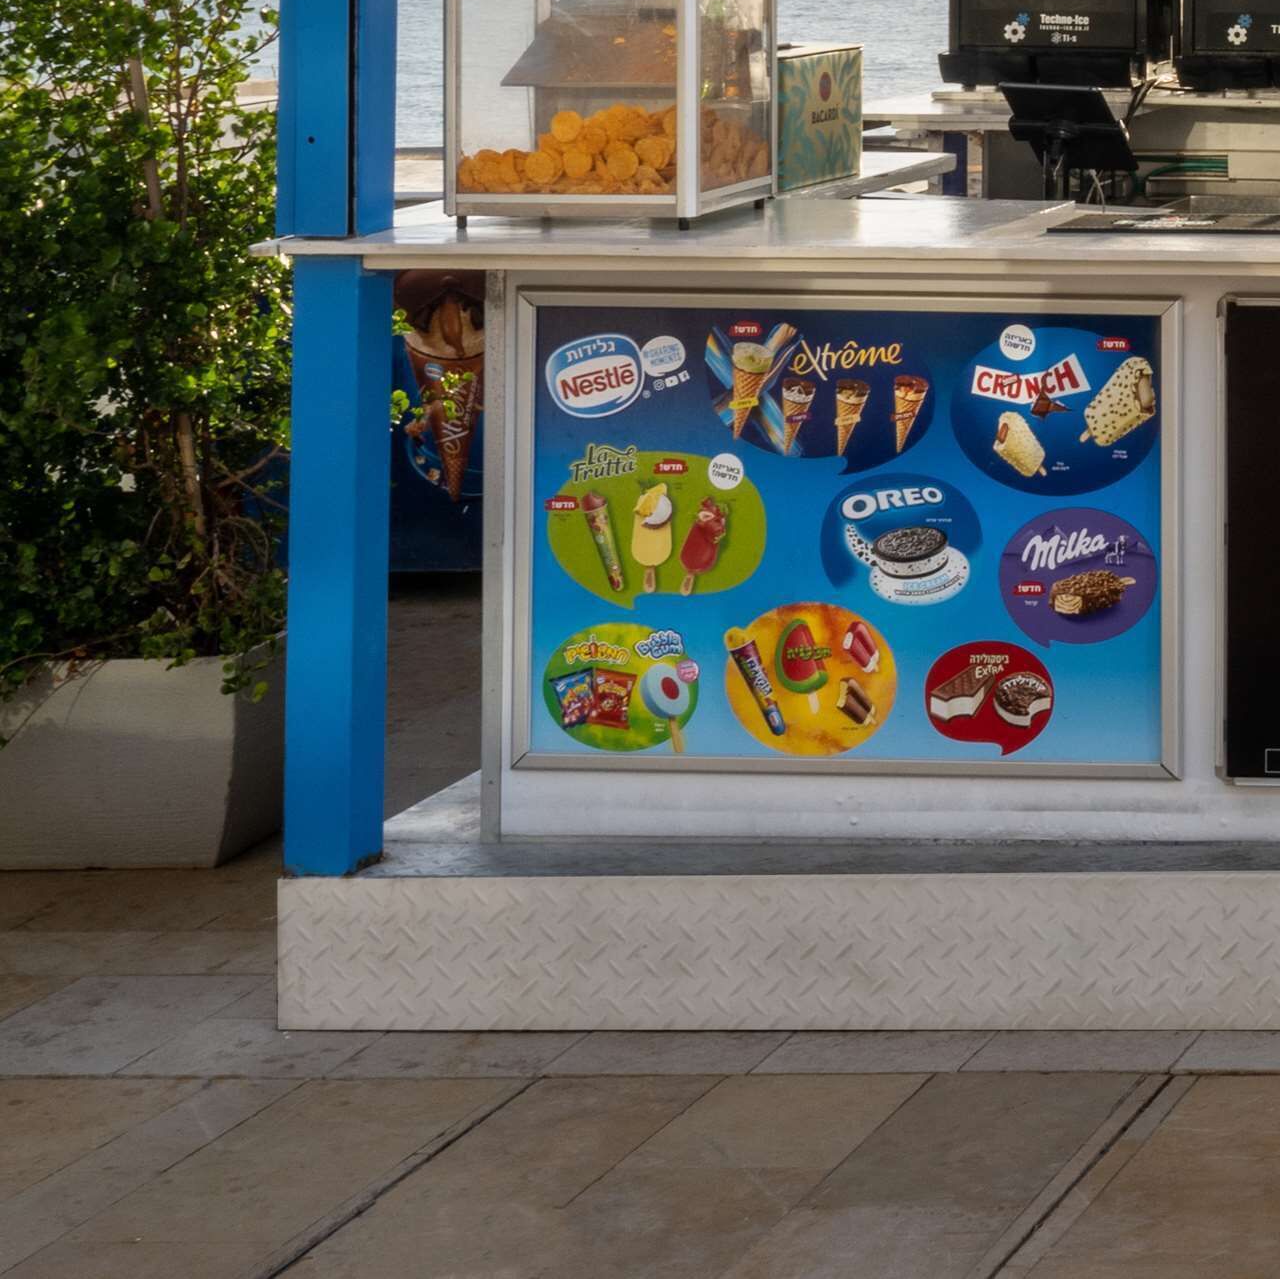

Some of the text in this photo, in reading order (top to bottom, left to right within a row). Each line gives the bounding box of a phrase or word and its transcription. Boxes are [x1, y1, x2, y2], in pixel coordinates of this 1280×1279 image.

[565, 339, 617, 363] גלידות
[976, 360, 1080, 400] CRUNCH
[842, 487, 943, 520] OREO
[1021, 528, 1110, 570] Milka
